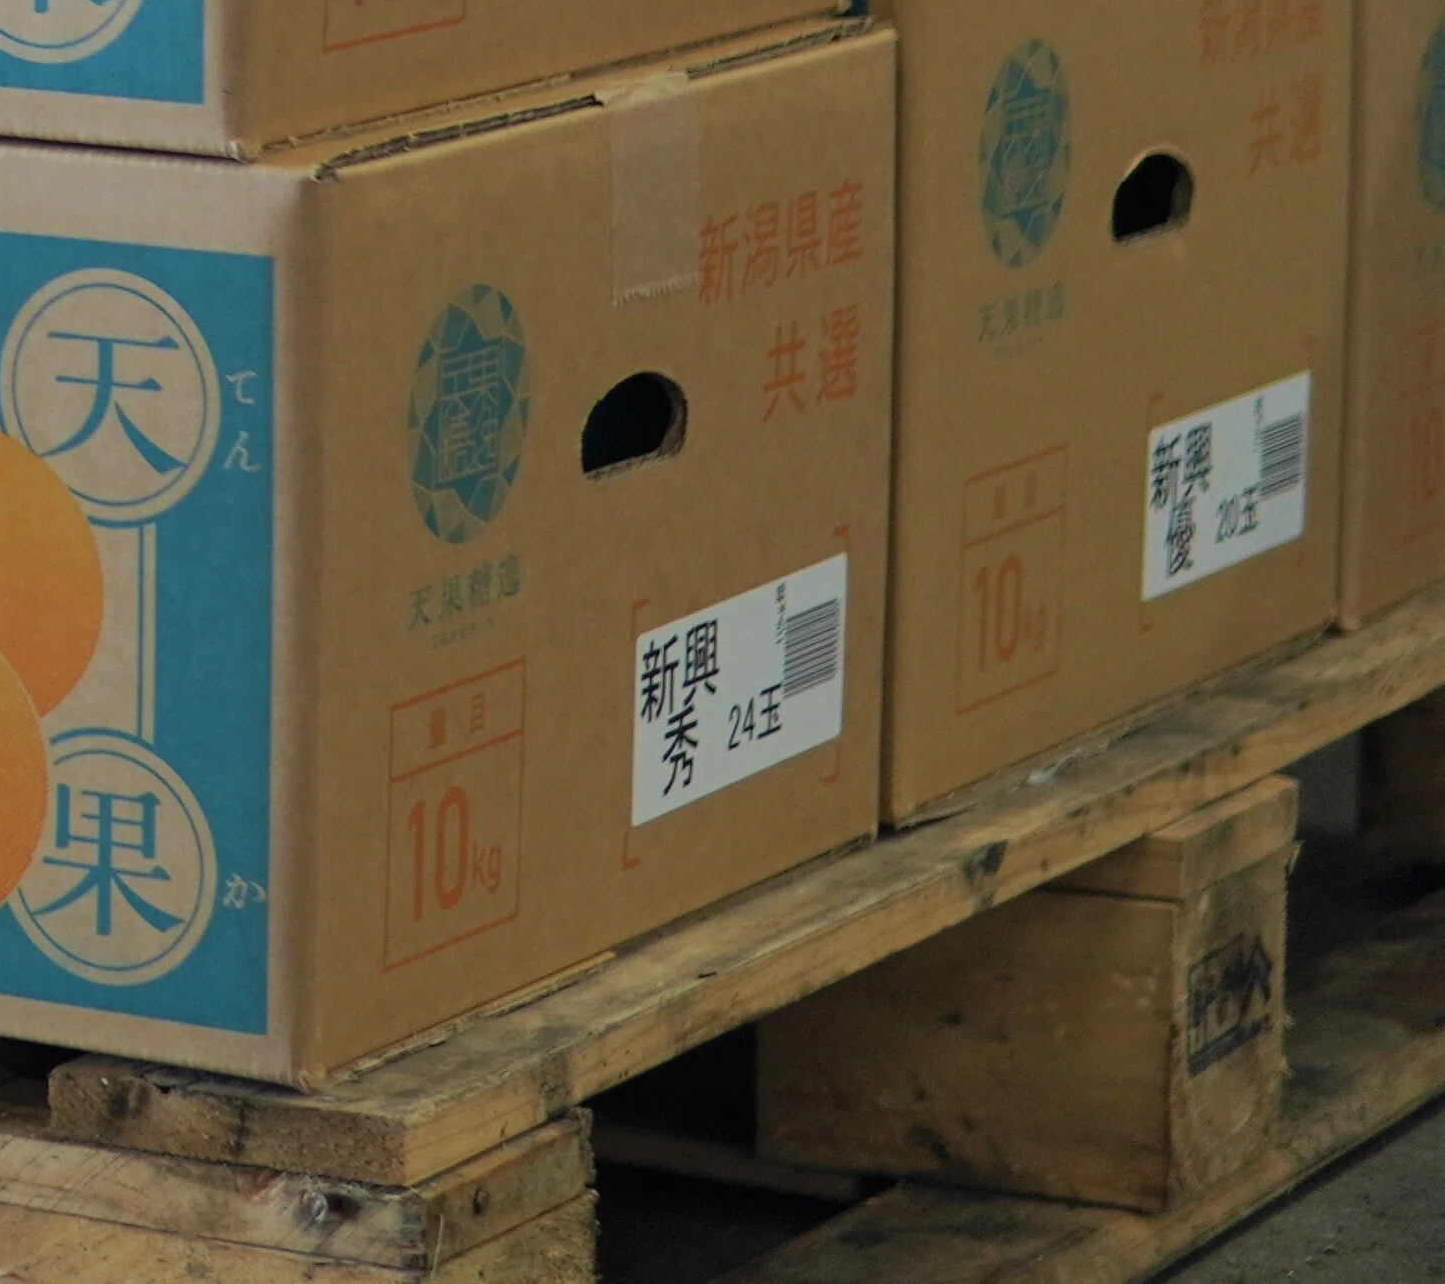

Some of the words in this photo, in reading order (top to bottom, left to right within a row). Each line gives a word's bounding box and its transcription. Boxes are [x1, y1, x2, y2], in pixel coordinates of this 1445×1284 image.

[696, 178, 862, 307] 新潟県産
[38, 331, 186, 475] 天
[224, 369, 259, 473] てん
[763, 304, 860, 421] 共選
[641, 619, 719, 723] 新興
[662, 705, 698, 797] 秀
[728, 684, 782, 752] 24玉
[30, 782, 184, 937] 果
[224, 874, 265, 910] か
[407, 785, 502, 921] 10kg
